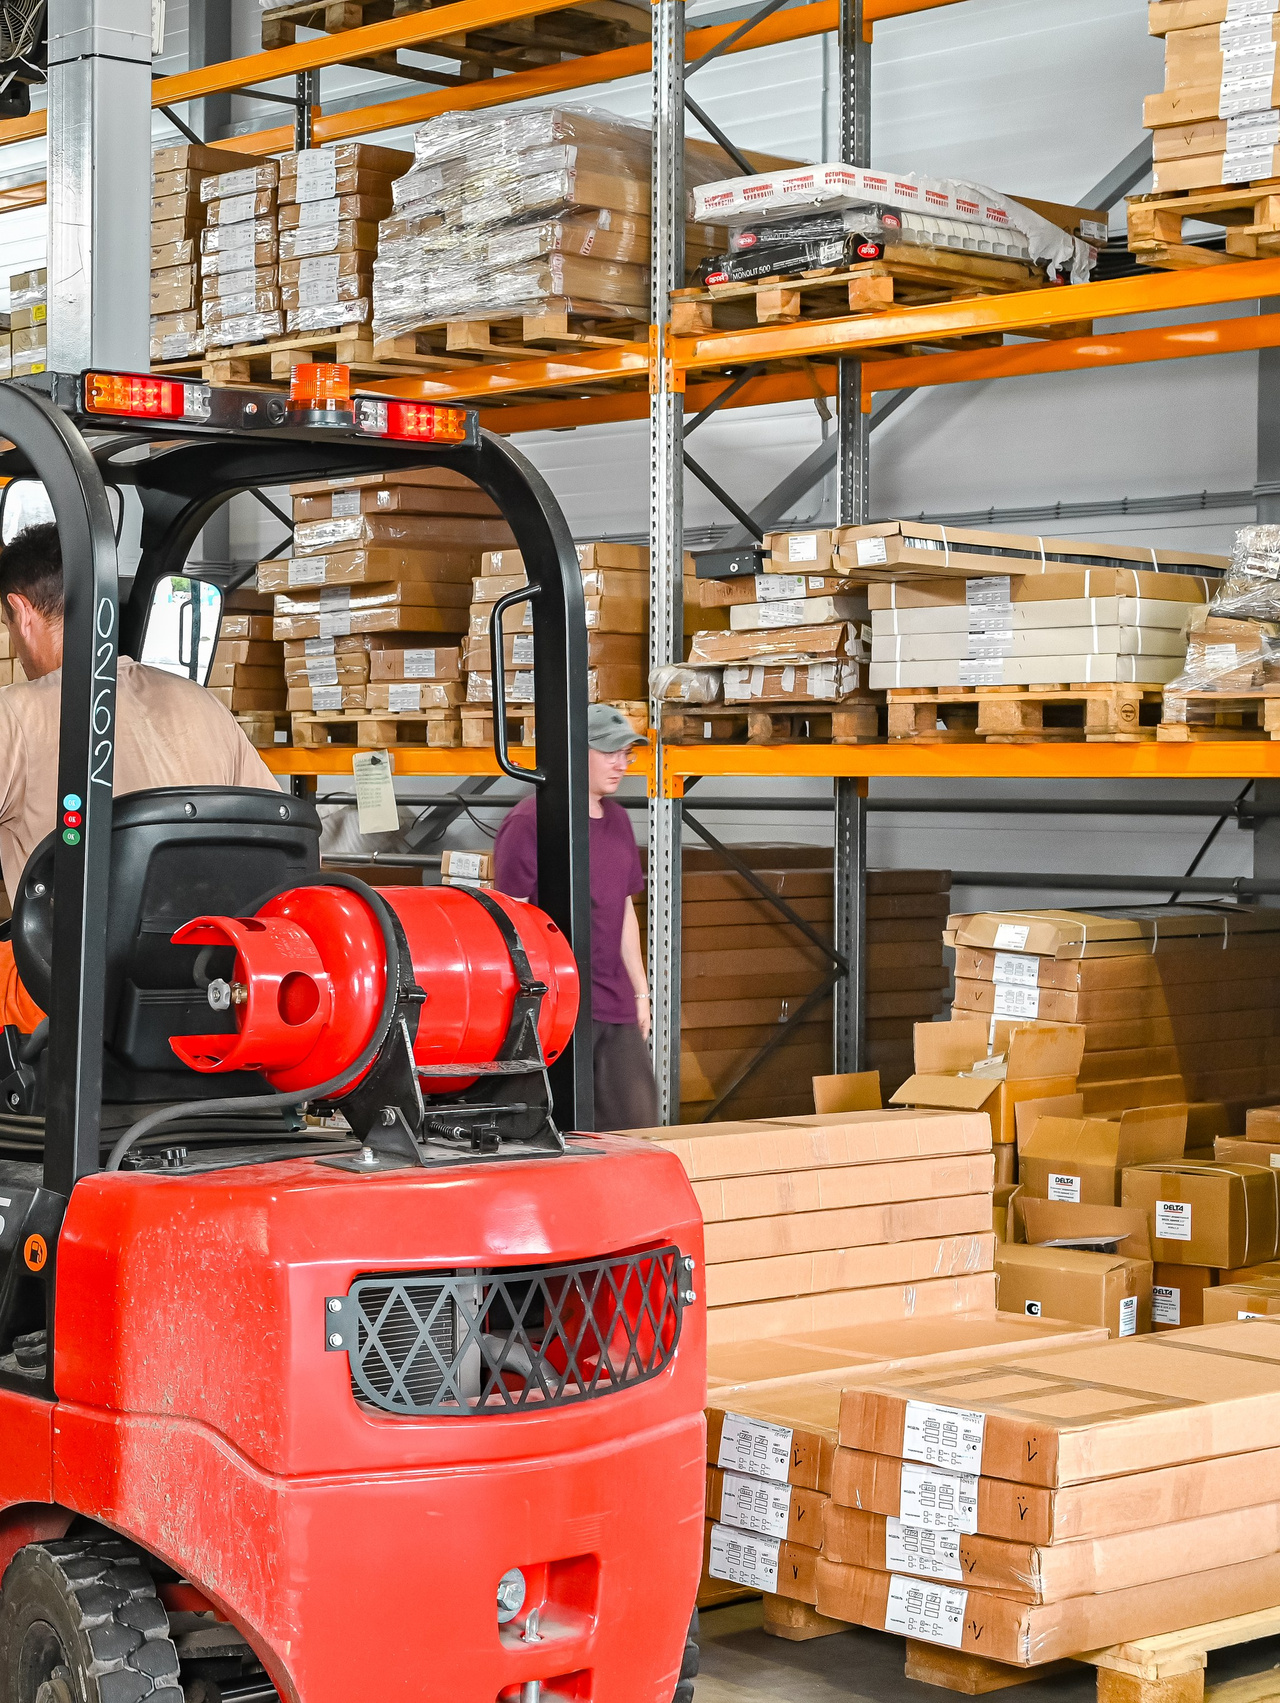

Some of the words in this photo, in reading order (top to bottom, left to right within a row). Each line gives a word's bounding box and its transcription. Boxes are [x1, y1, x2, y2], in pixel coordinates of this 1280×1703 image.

[732, 267, 758, 280] MONOLIT
[759, 264, 771, 275] 500
[90, 597, 116, 787] 0262
[1055, 1177, 1073, 1185] DELTA
[1152, 1287, 1172, 1296] DELTA
